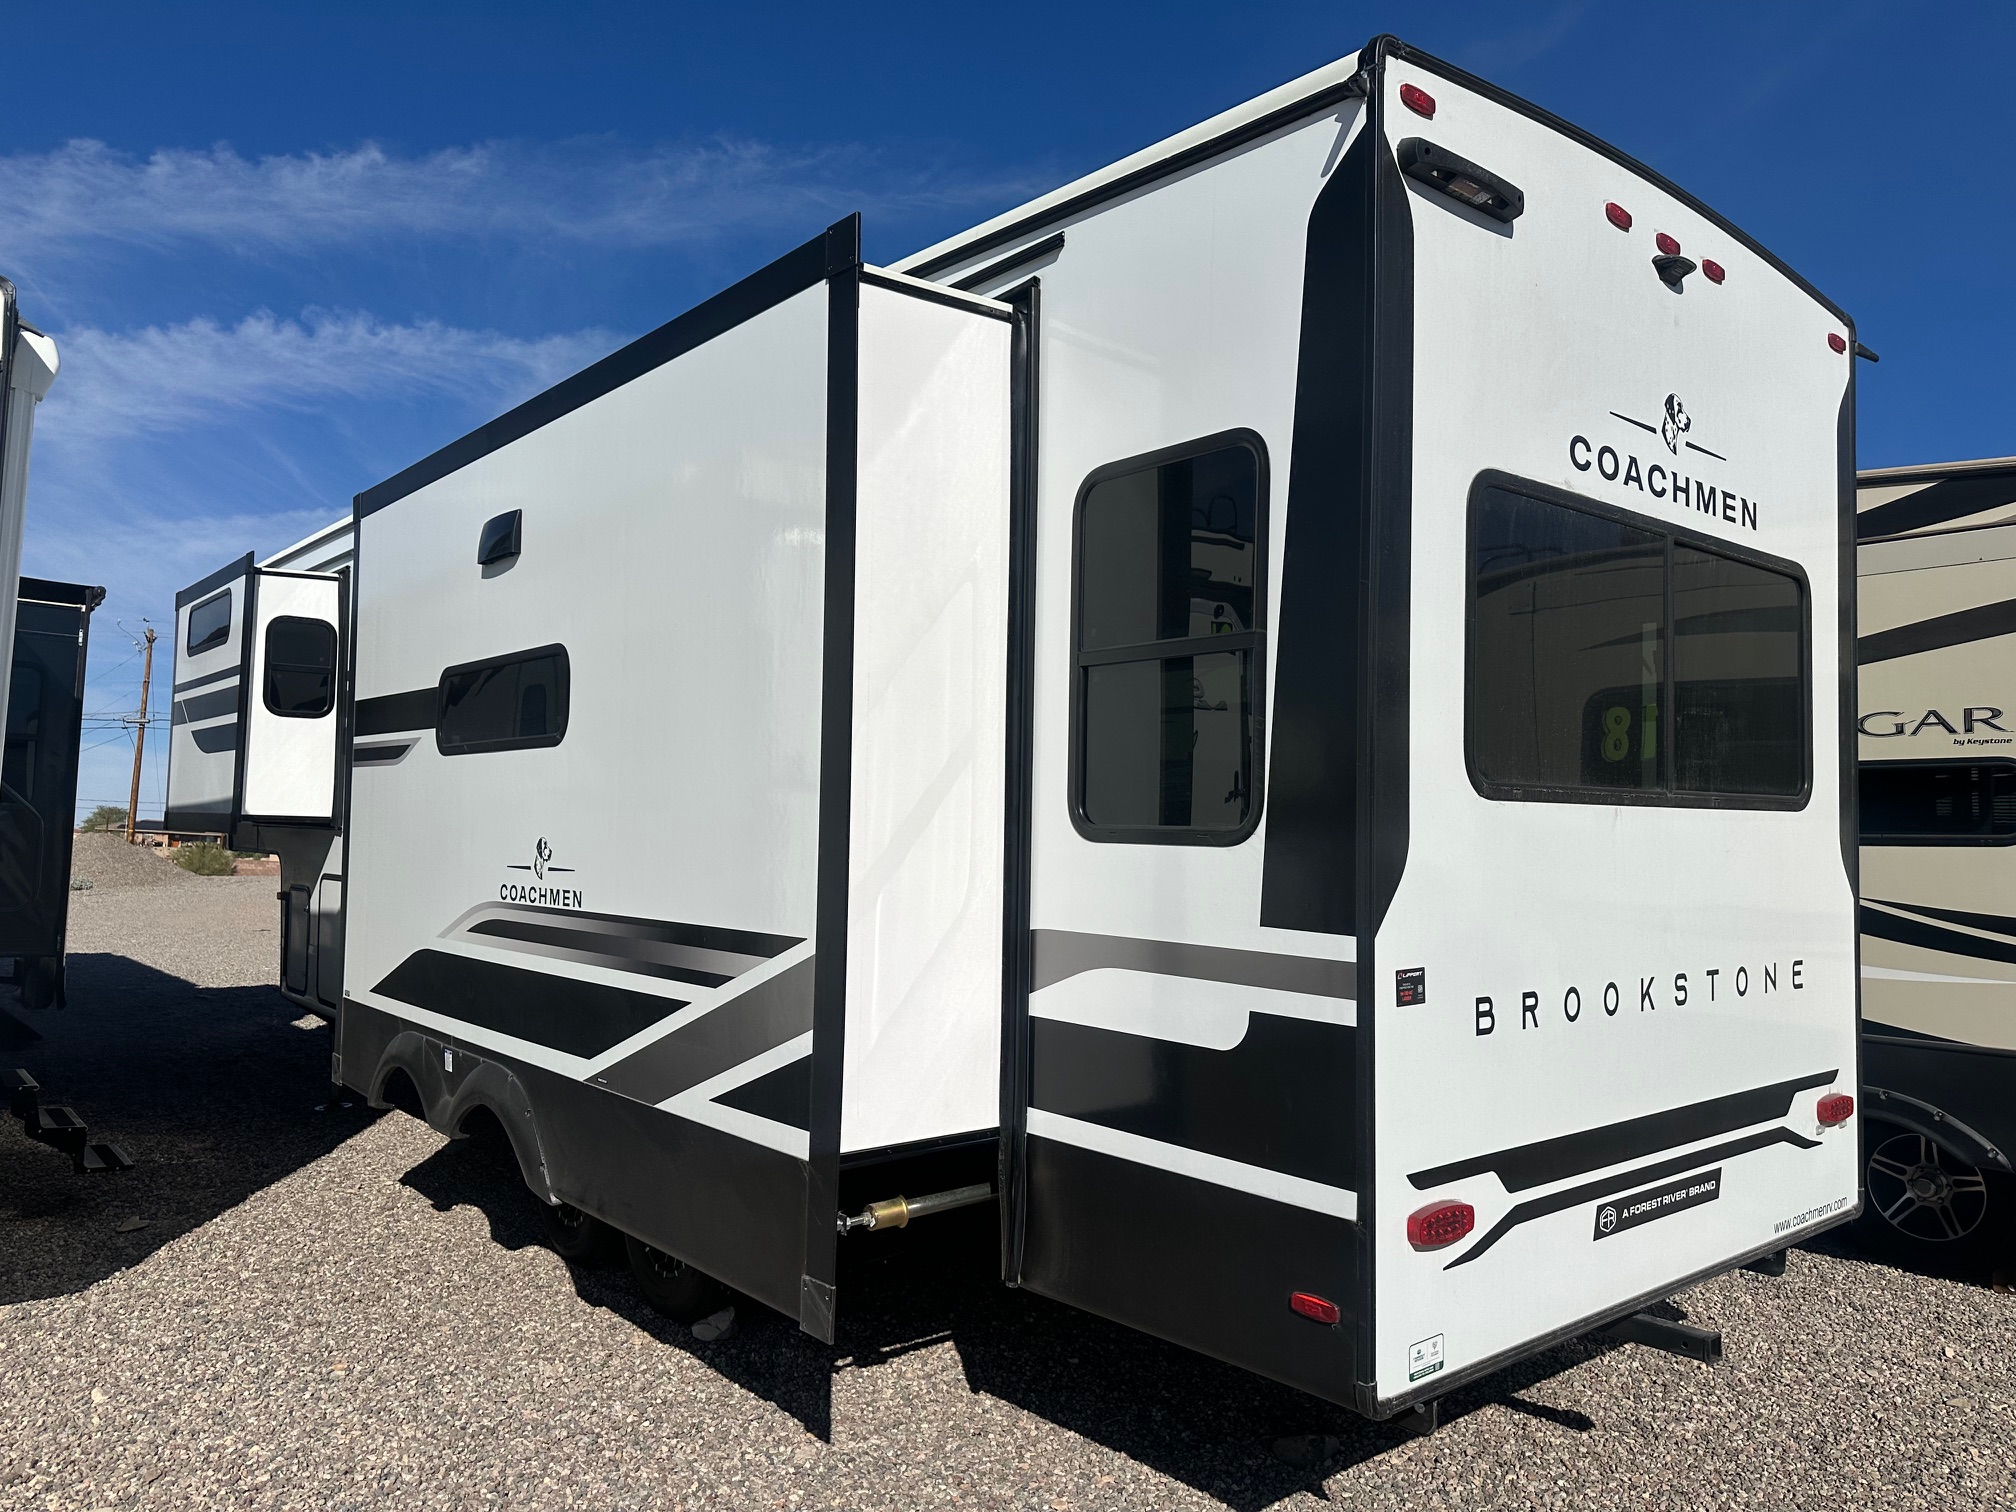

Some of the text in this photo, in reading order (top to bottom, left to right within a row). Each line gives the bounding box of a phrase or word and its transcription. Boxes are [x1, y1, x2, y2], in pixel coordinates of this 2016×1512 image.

[1569, 435, 1757, 531] COACHMEN
[1953, 738, 2012, 746] by Keystone
[500, 884, 582, 908] COACHMEN
[1475, 959, 1804, 1036] BROOKSTONE
[1622, 1208, 1629, 1219] A
[1629, 1198, 1662, 1216] FOREST
[1689, 1180, 1716, 1197] BRAND
[1773, 1196, 1848, 1234] www.coachmenrv.com
